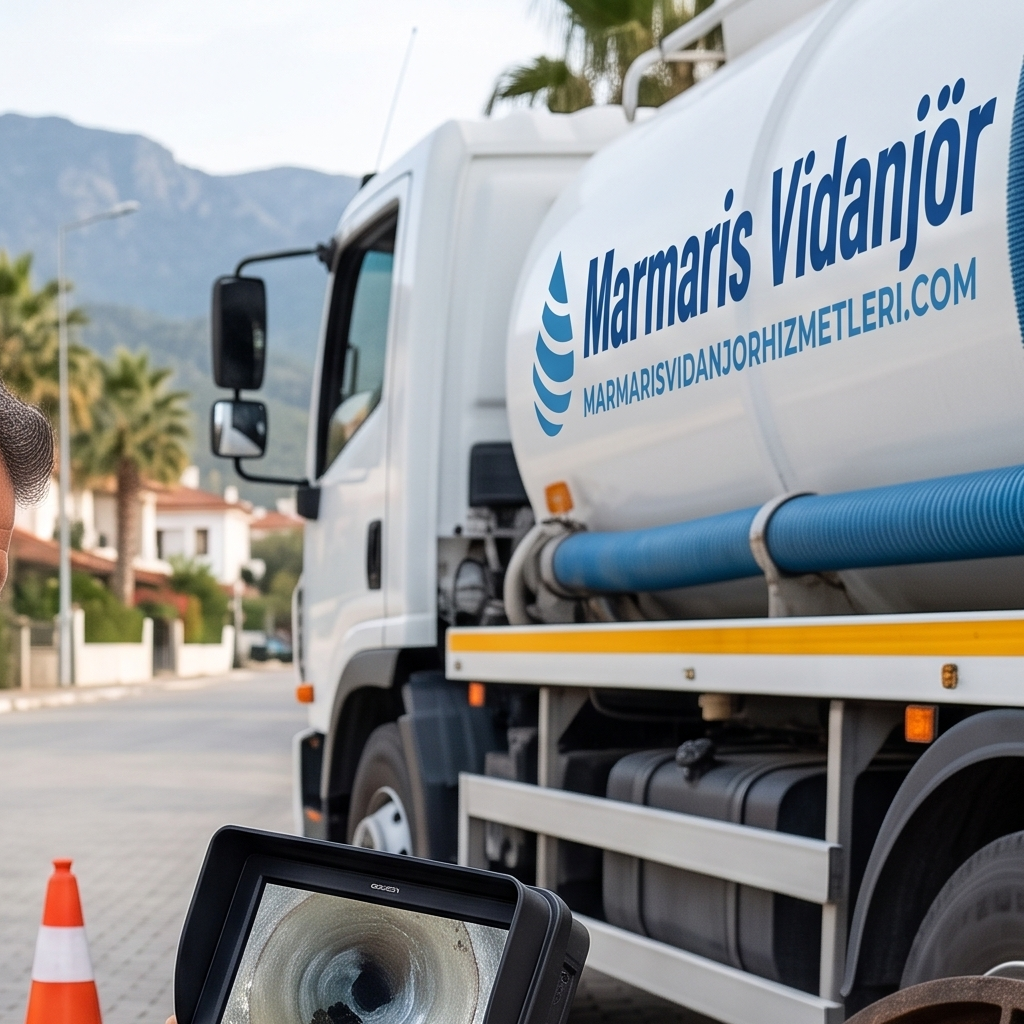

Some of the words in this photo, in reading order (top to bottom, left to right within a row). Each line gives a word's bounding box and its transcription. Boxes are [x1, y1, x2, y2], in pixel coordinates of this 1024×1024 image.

[583, 188, 753, 358] Marmaris
[772, 77, 997, 287] Vidanjör
[583, 256, 977, 418] MARMARISVIDANJORHIZMETLERI.COM
